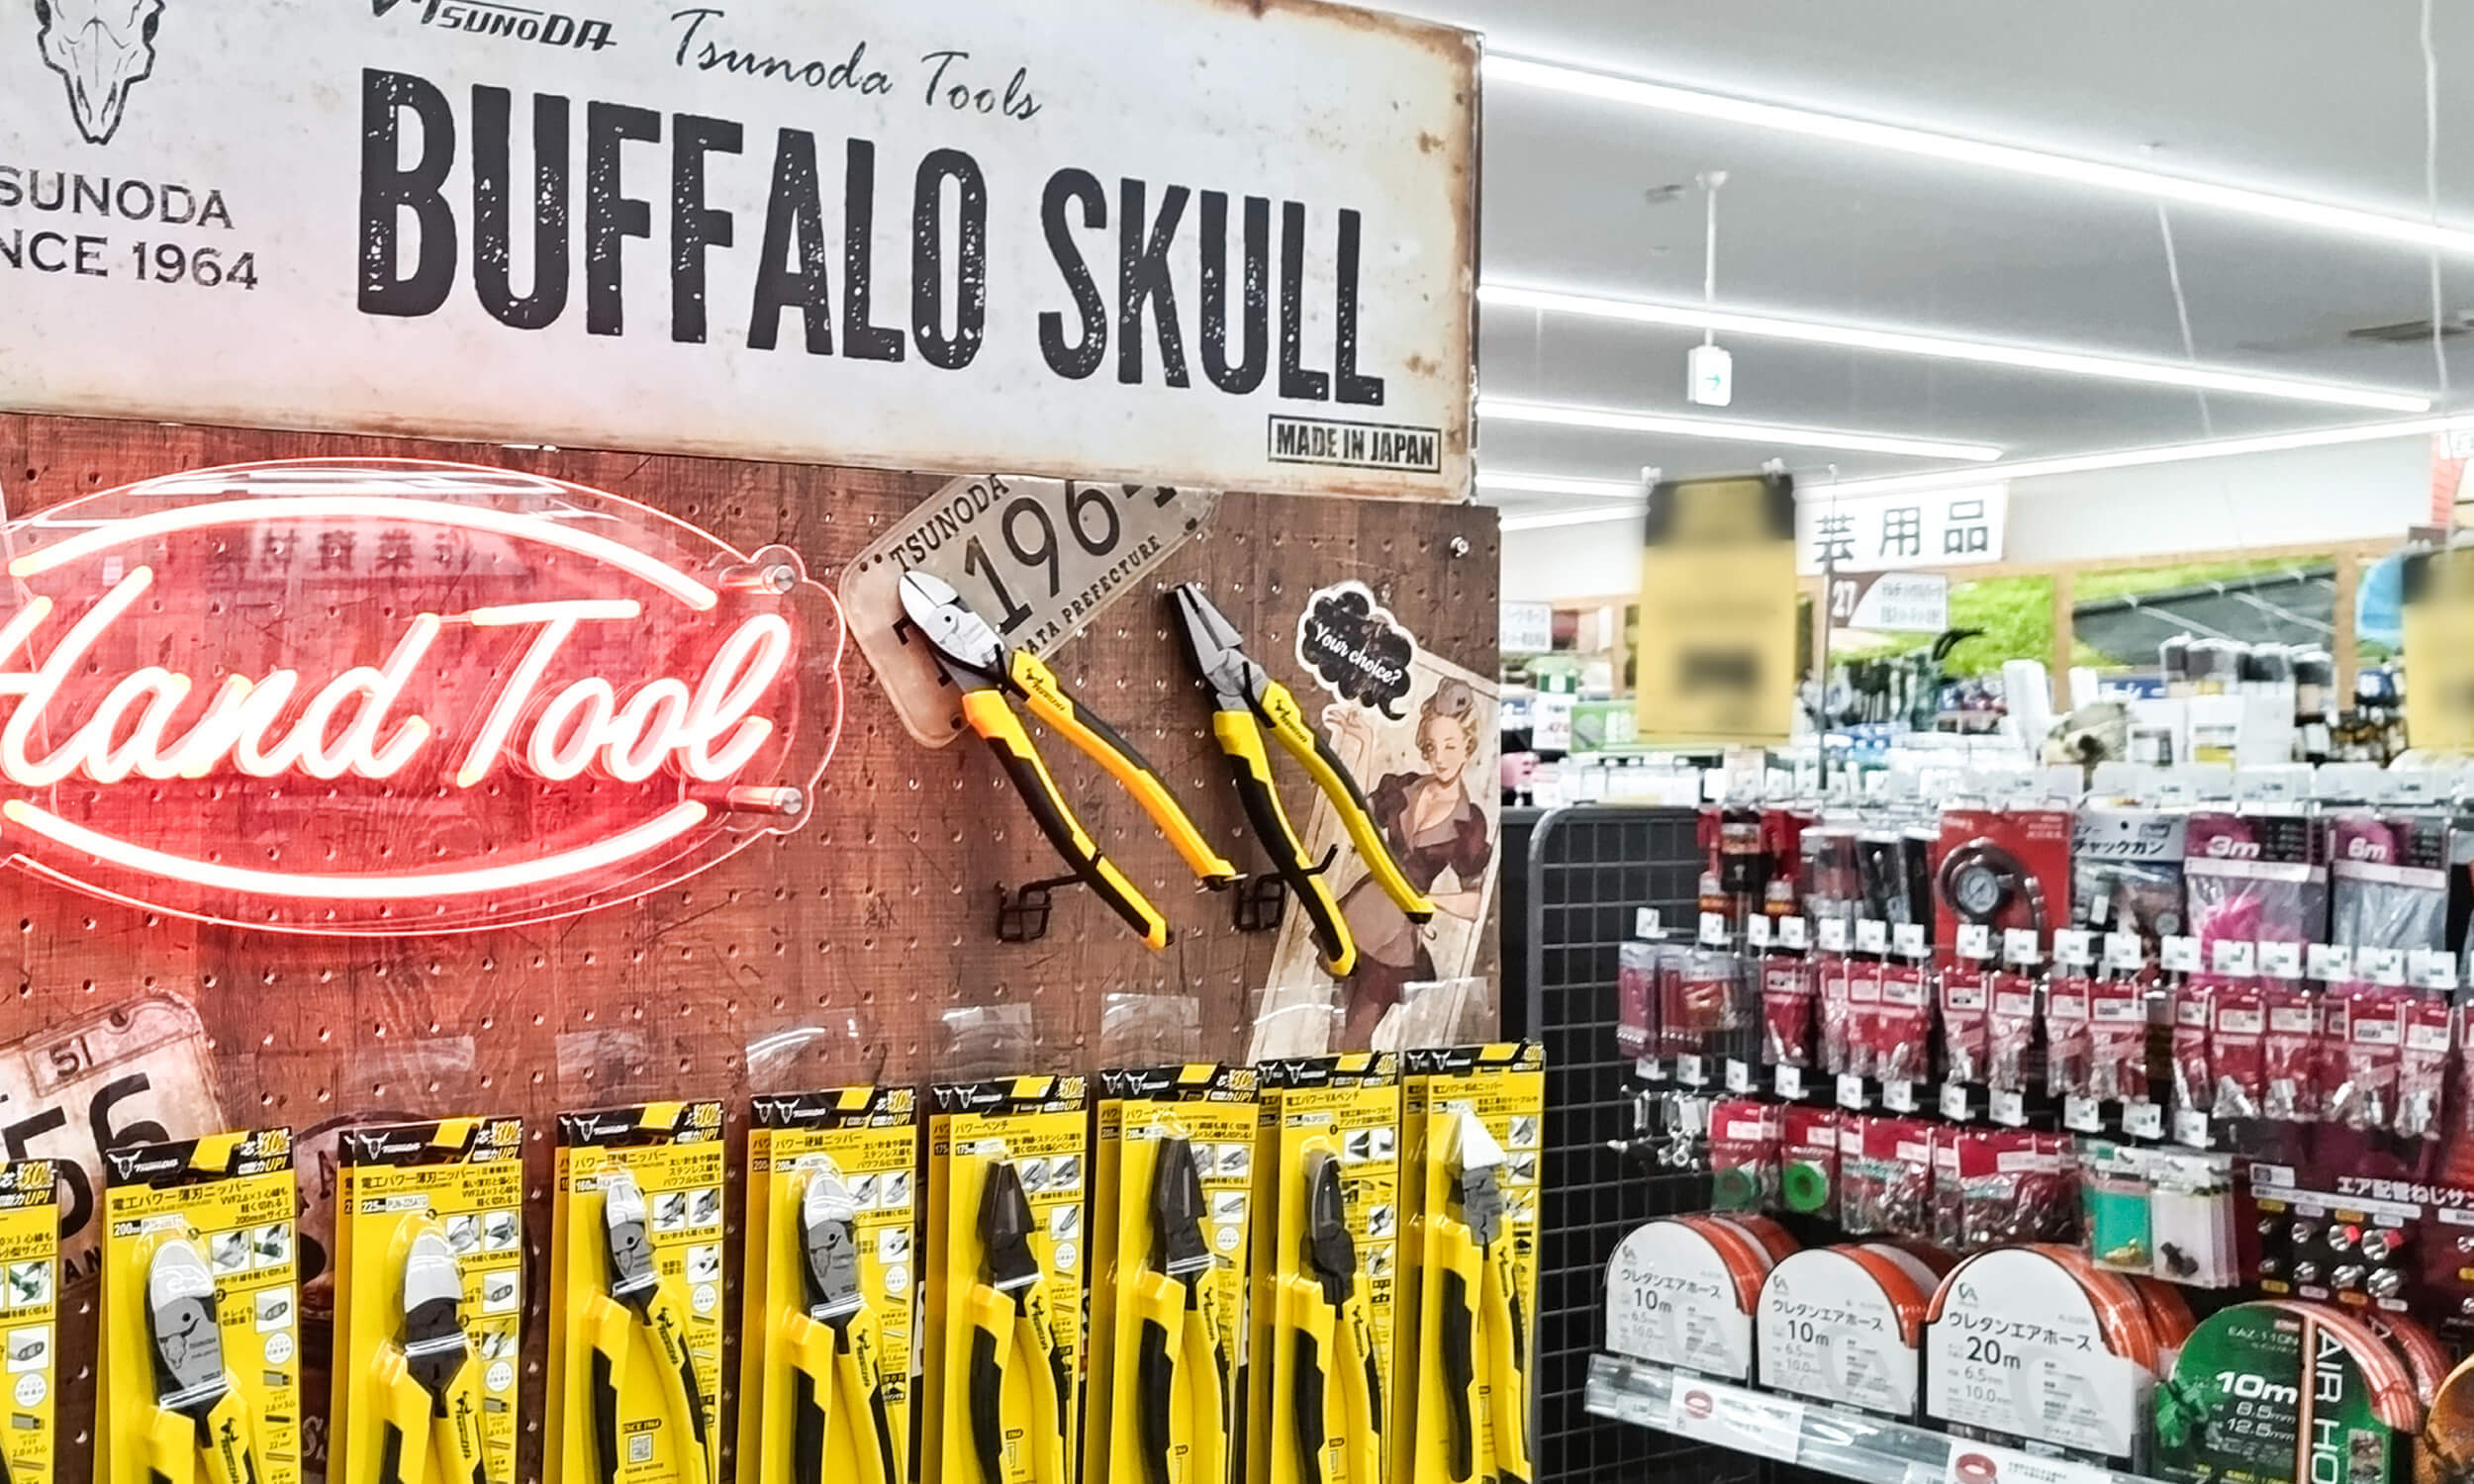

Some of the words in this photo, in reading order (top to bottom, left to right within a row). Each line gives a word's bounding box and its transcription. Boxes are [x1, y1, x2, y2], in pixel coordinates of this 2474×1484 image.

[671, 9, 892, 95] Tsunoda
[921, 51, 1042, 120] Tools
[358, 67, 987, 370] BUFFALO
[1039, 167, 1383, 406] SKULL
[133, 241, 258, 290] 1964
[1277, 423, 1337, 458] MADE
[1343, 428, 1365, 460] IN
[1371, 431, 1433, 465] JAPAN
[889, 473, 1009, 572] TSUNODA
[1061, 535, 1162, 621] PREFECTURE
[1313, 622, 1348, 657] Your
[1348, 642, 1401, 686] choice?
[0, 565, 429, 787] Hand
[454, 600, 793, 788] Tool
[2205, 836, 2261, 858] 3m
[2348, 837, 2387, 861] 6m
[1621, 1269, 1721, 1299] ウレタンエアホース
[1635, 1287, 1671, 1314] 10m
[1773, 1299, 1884, 1332] ウレタンエアホース
[1787, 1320, 1829, 1346] 10m
[1950, 1312, 2092, 1352] ウレタンエアホース
[1966, 1336, 2021, 1370] 20m
[2315, 1327, 2344, 1403] AIR
[2216, 1371, 2298, 1405] 10m
